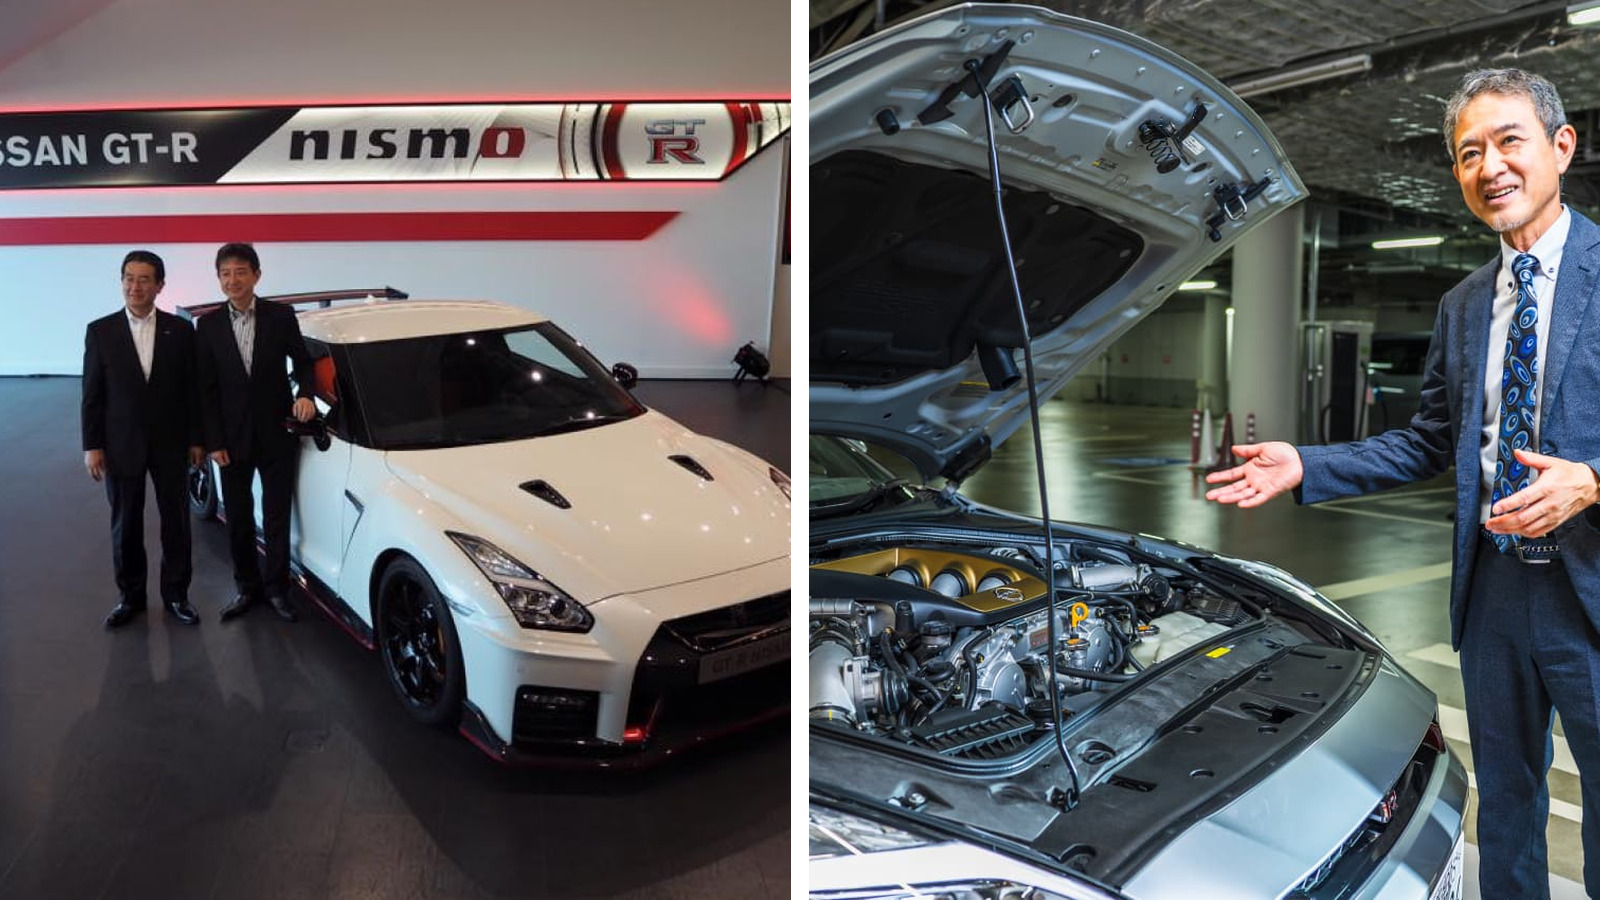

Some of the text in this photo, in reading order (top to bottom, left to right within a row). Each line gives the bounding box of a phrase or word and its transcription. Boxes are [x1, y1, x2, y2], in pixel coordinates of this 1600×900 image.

[0, 131, 199, 166] SAN GT-R
[289, 127, 525, 160] nismo
